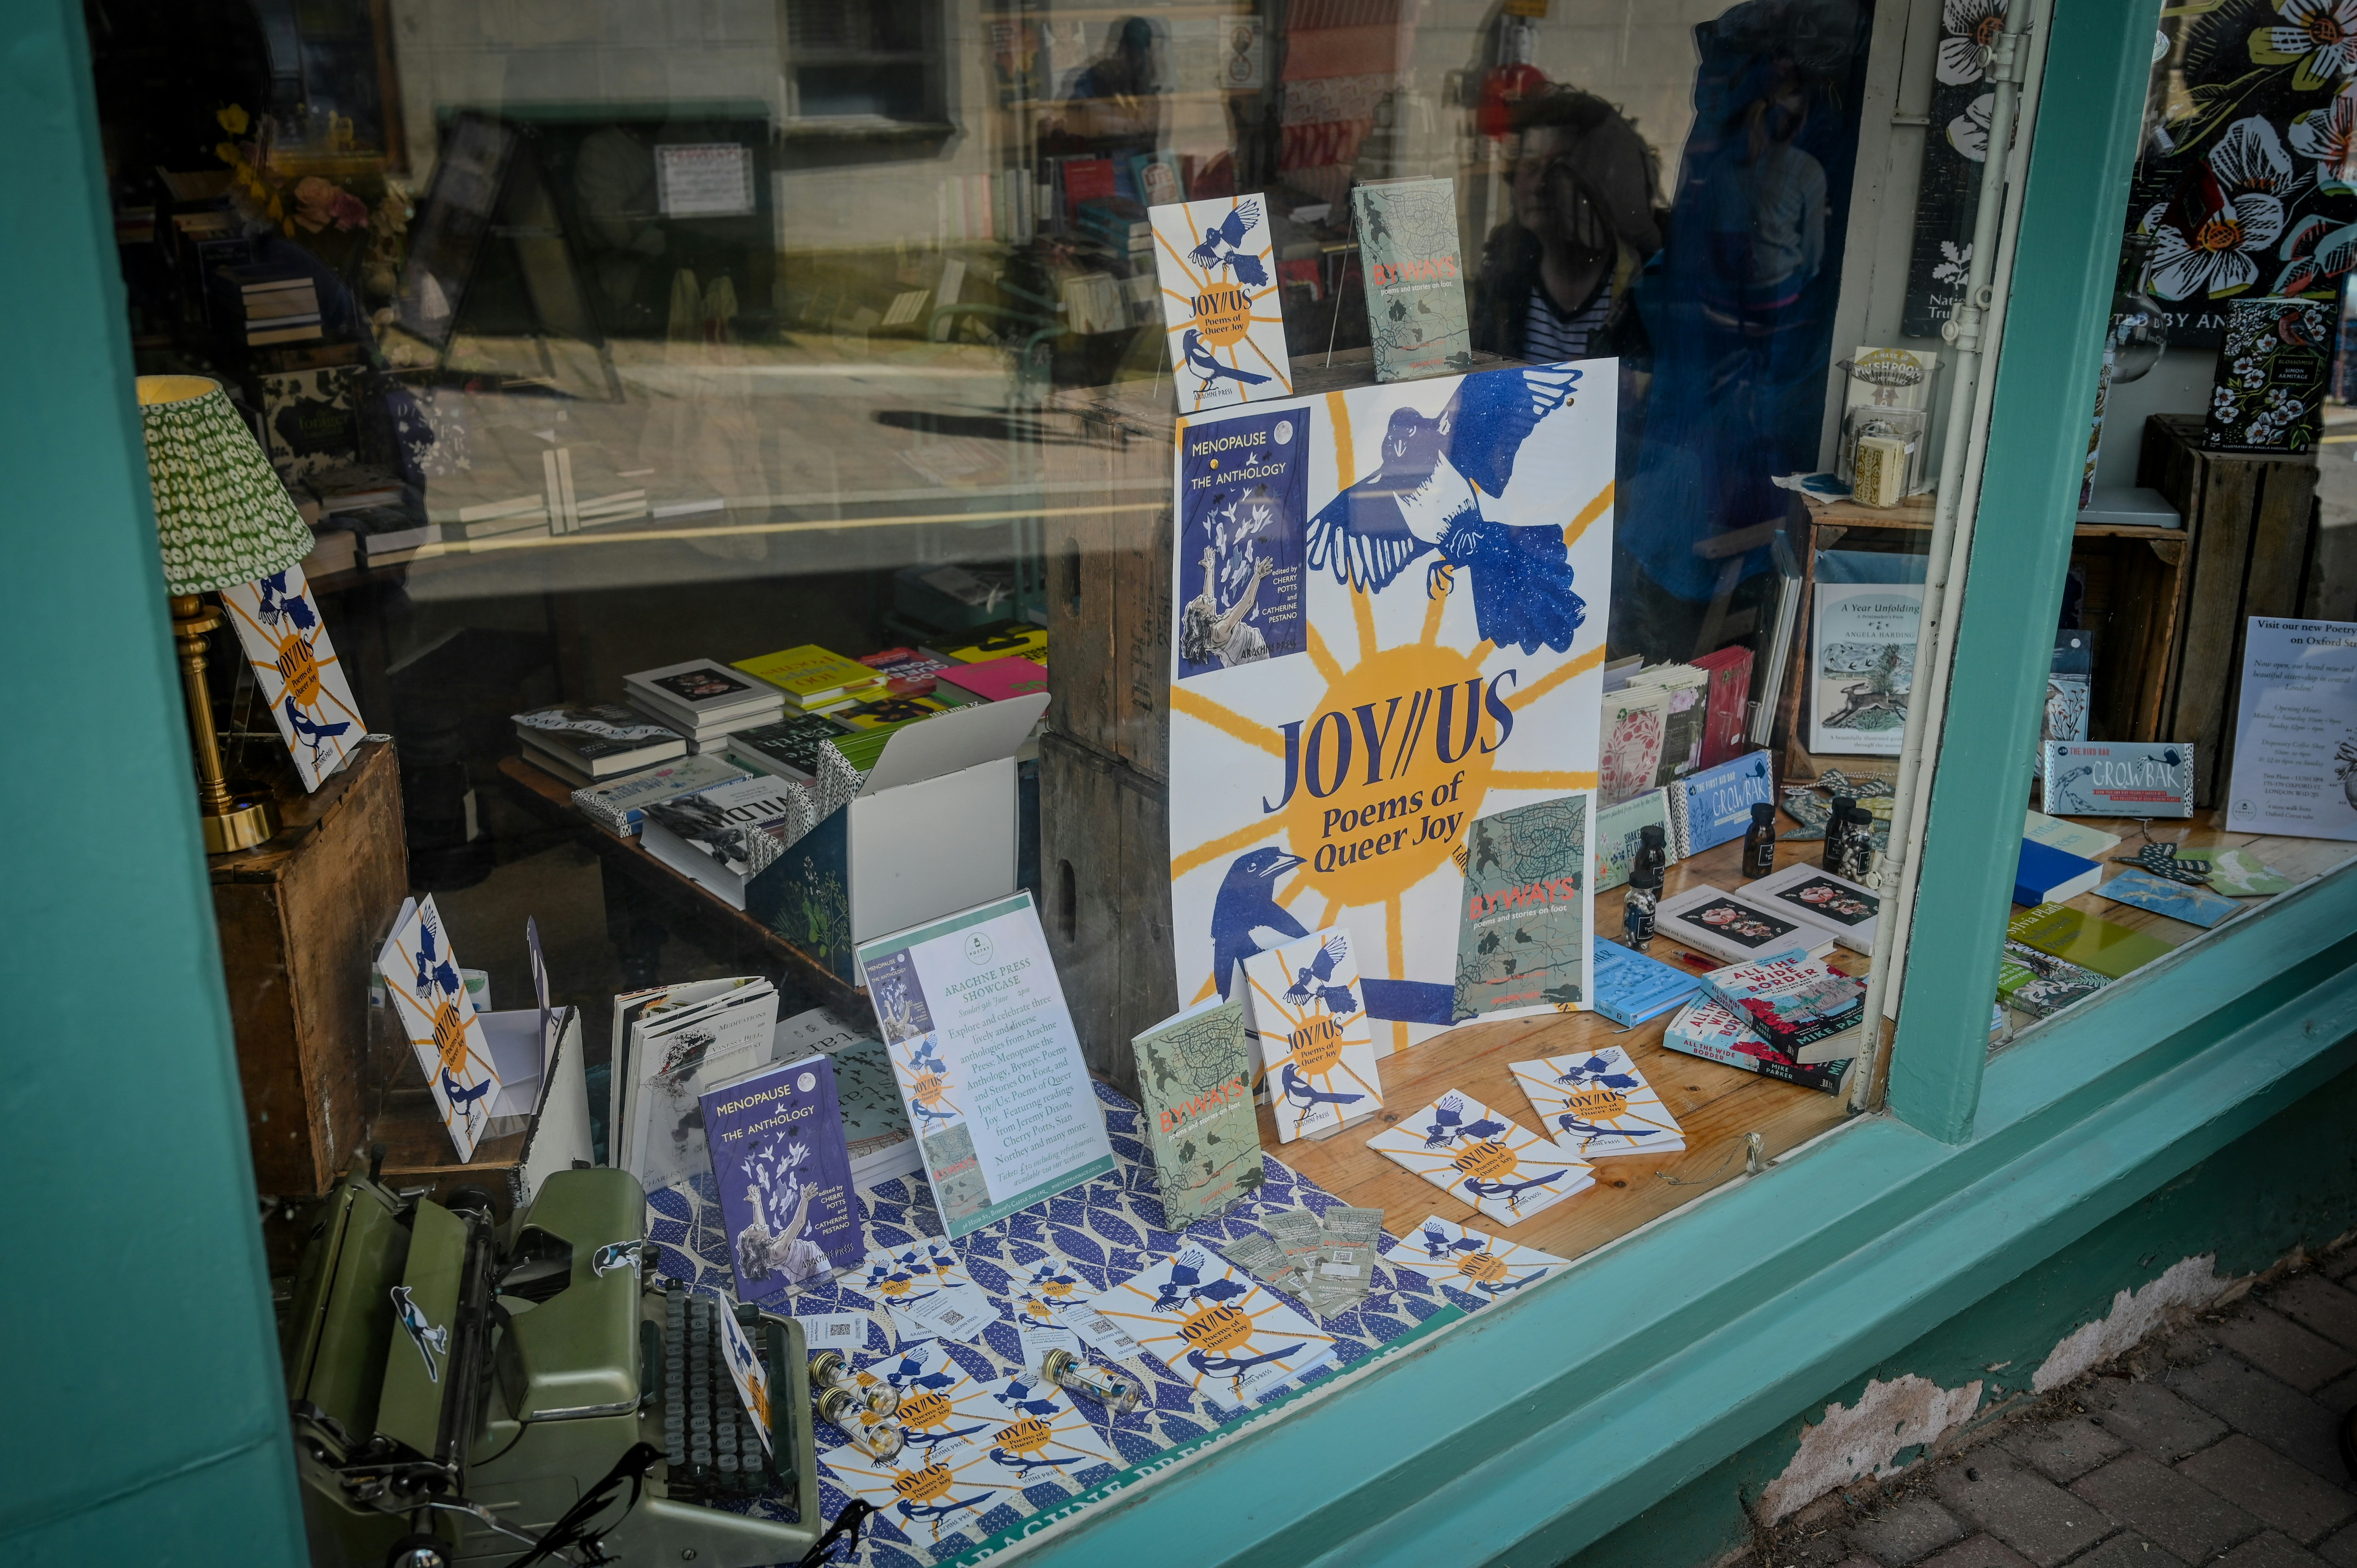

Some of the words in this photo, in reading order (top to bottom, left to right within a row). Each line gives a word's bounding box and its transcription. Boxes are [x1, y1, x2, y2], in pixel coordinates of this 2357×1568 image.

[1373, 256, 1455, 285] BYWAYS
[1189, 288, 1252, 318] JOY//US
[1381, 288, 1399, 297] poems
[1205, 318, 1231, 326] Poems
[1205, 326, 1229, 335] Queer
[1193, 431, 1266, 457] MENOPAUSE
[1191, 476, 1211, 490] THE
[1216, 463, 1286, 485] ANTHOLOGY
[1273, 574, 1297, 584] CHERRY
[1277, 584, 1297, 593] POTTS
[1262, 602, 1297, 615] CATHERINE
[1269, 612, 1297, 623] PESTANO
[1875, 604, 1919, 614] Unfolding
[2258, 620, 2279, 629] Visit
[2306, 637, 2341, 646] Oxford
[1263, 669, 1516, 813] JOY//US
[1696, 782, 1705, 794] THE
[1705, 777, 1718, 791] FIRST
[1719, 773, 1727, 786] AID
[1726, 770, 1736, 782] BAR
[2092, 760, 2180, 790] GROWBAR
[1322, 790, 1423, 839] Poems
[1431, 770, 1465, 806] of
[1713, 777, 1767, 816] GROWBAR
[1314, 827, 1408, 873] Queer
[1413, 812, 1463, 846] Joy
[1470, 878, 1574, 920] BYWAYS
[1474, 918, 1495, 931] poems
[1497, 914, 1510, 922] and
[1512, 910, 1536, 919] stories
[1657, 924, 1670, 934] POEMS
[1671, 929, 1679, 938] FOR
[1680, 933, 1701, 946] TORTURED
[1702, 943, 1716, 952] SOULS
[945, 970, 997, 997] ARACHNE
[999, 958, 1030, 976] PRESS
[1734, 968, 1763, 979] ALL
[1766, 959, 1797, 970] THE
[1746, 968, 1817, 992] BORDER
[1751, 968, 1796, 982] WIDE
[963, 975, 1021, 1003] SHOWCASE
[959, 1005, 980, 1018] Sunday
[982, 999, 992, 1012] 9th
[1017, 987, 1030, 997] 2pm
[947, 1023, 980, 1039] Explore
[982, 1014, 996, 1027] and
[997, 1004, 1030, 1021] celebrate
[1032, 996, 1051, 1008] three
[972, 1031, 993, 1045] lively
[995, 1023, 1010, 1036] and
[1009, 1016, 1036, 1031] diverse
[960, 1042, 1005, 1064] anthologies
[1005, 1035, 1025, 1046] from
[1027, 1022, 1057, 1038] Arachne
[1286, 1017, 1343, 1054] JOY//US
[1684, 1039, 1697, 1048] ALL
[1699, 1044, 1713, 1052] THE
[1714, 1047, 1736, 1058] WIDE
[1796, 1028, 1834, 1045] MIKE
[972, 1060, 995, 1074] Press:
[996, 1043, 1040, 1064] Menopause
[1041, 1037, 1053, 1046] the
[1301, 1047, 1325, 1058] Poems
[1327, 1041, 1333, 1049] of
[1302, 1055, 1323, 1066] Queer
[1693, 1047, 1724, 1061] BORDER
[967, 1069, 1010, 1091] Anthology,
[1010, 1056, 1041, 1074] Byways:
[1041, 1046, 1067, 1060] Poems
[974, 1088, 989, 1102] and
[989, 1080, 1017, 1095] Stories
[1018, 1074, 1032, 1083] On
[1032, 1066, 1054, 1079] Foot,
[1054, 1056, 1068, 1070] and
[717, 1084, 791, 1117] MENOPAUSE
[977, 1096, 1011, 1118] Joy//Us:
[1011, 1086, 1037, 1101] Poems
[1039, 1079, 1046, 1090] of
[1044, 1072, 1071, 1086] Queer
[984, 1116, 1001, 1130] Joy.
[1003, 1098, 1042, 1119] Featuring
[1043, 1086, 1074, 1103] readings
[1160, 1077, 1244, 1133] BYWAYS
[1562, 1090, 1627, 1109] JOY//US
[722, 1128, 743, 1142] THE
[748, 1105, 814, 1135] ANTHOLOGY
[996, 1124, 1016, 1137] from
[1016, 1111, 1043, 1131] Jeremy
[1044, 1102, 1072, 1116] Dixon,
[1003, 1131, 1030, 1147] Cherry
[1032, 1123, 1055, 1136] Potts,
[1055, 1114, 1072, 1126] Sian
[1168, 1128, 1187, 1142] poems
[1188, 1121, 1198, 1131] and
[1200, 1112, 1218, 1125] stories
[1228, 1102, 1240, 1111] foot
[1293, 1116, 1315, 1129] ARACHNE
[1316, 1111, 1329, 1121] PRESS
[994, 1147, 1028, 1166] Northey
[1030, 1137, 1044, 1151] and
[1045, 1131, 1065, 1145] many
[1067, 1123, 1088, 1135] more.
[1449, 1137, 1506, 1175] JOY//US
[1474, 1159, 1497, 1172] Poems
[1480, 1164, 1500, 1176] Queer
[819, 1186, 835, 1196] edited
[821, 1191, 844, 1203] CHERRY
[827, 1199, 846, 1210] POTTS
[815, 1214, 848, 1229] CATHERINE
[823, 1222, 850, 1235] PESTANO
